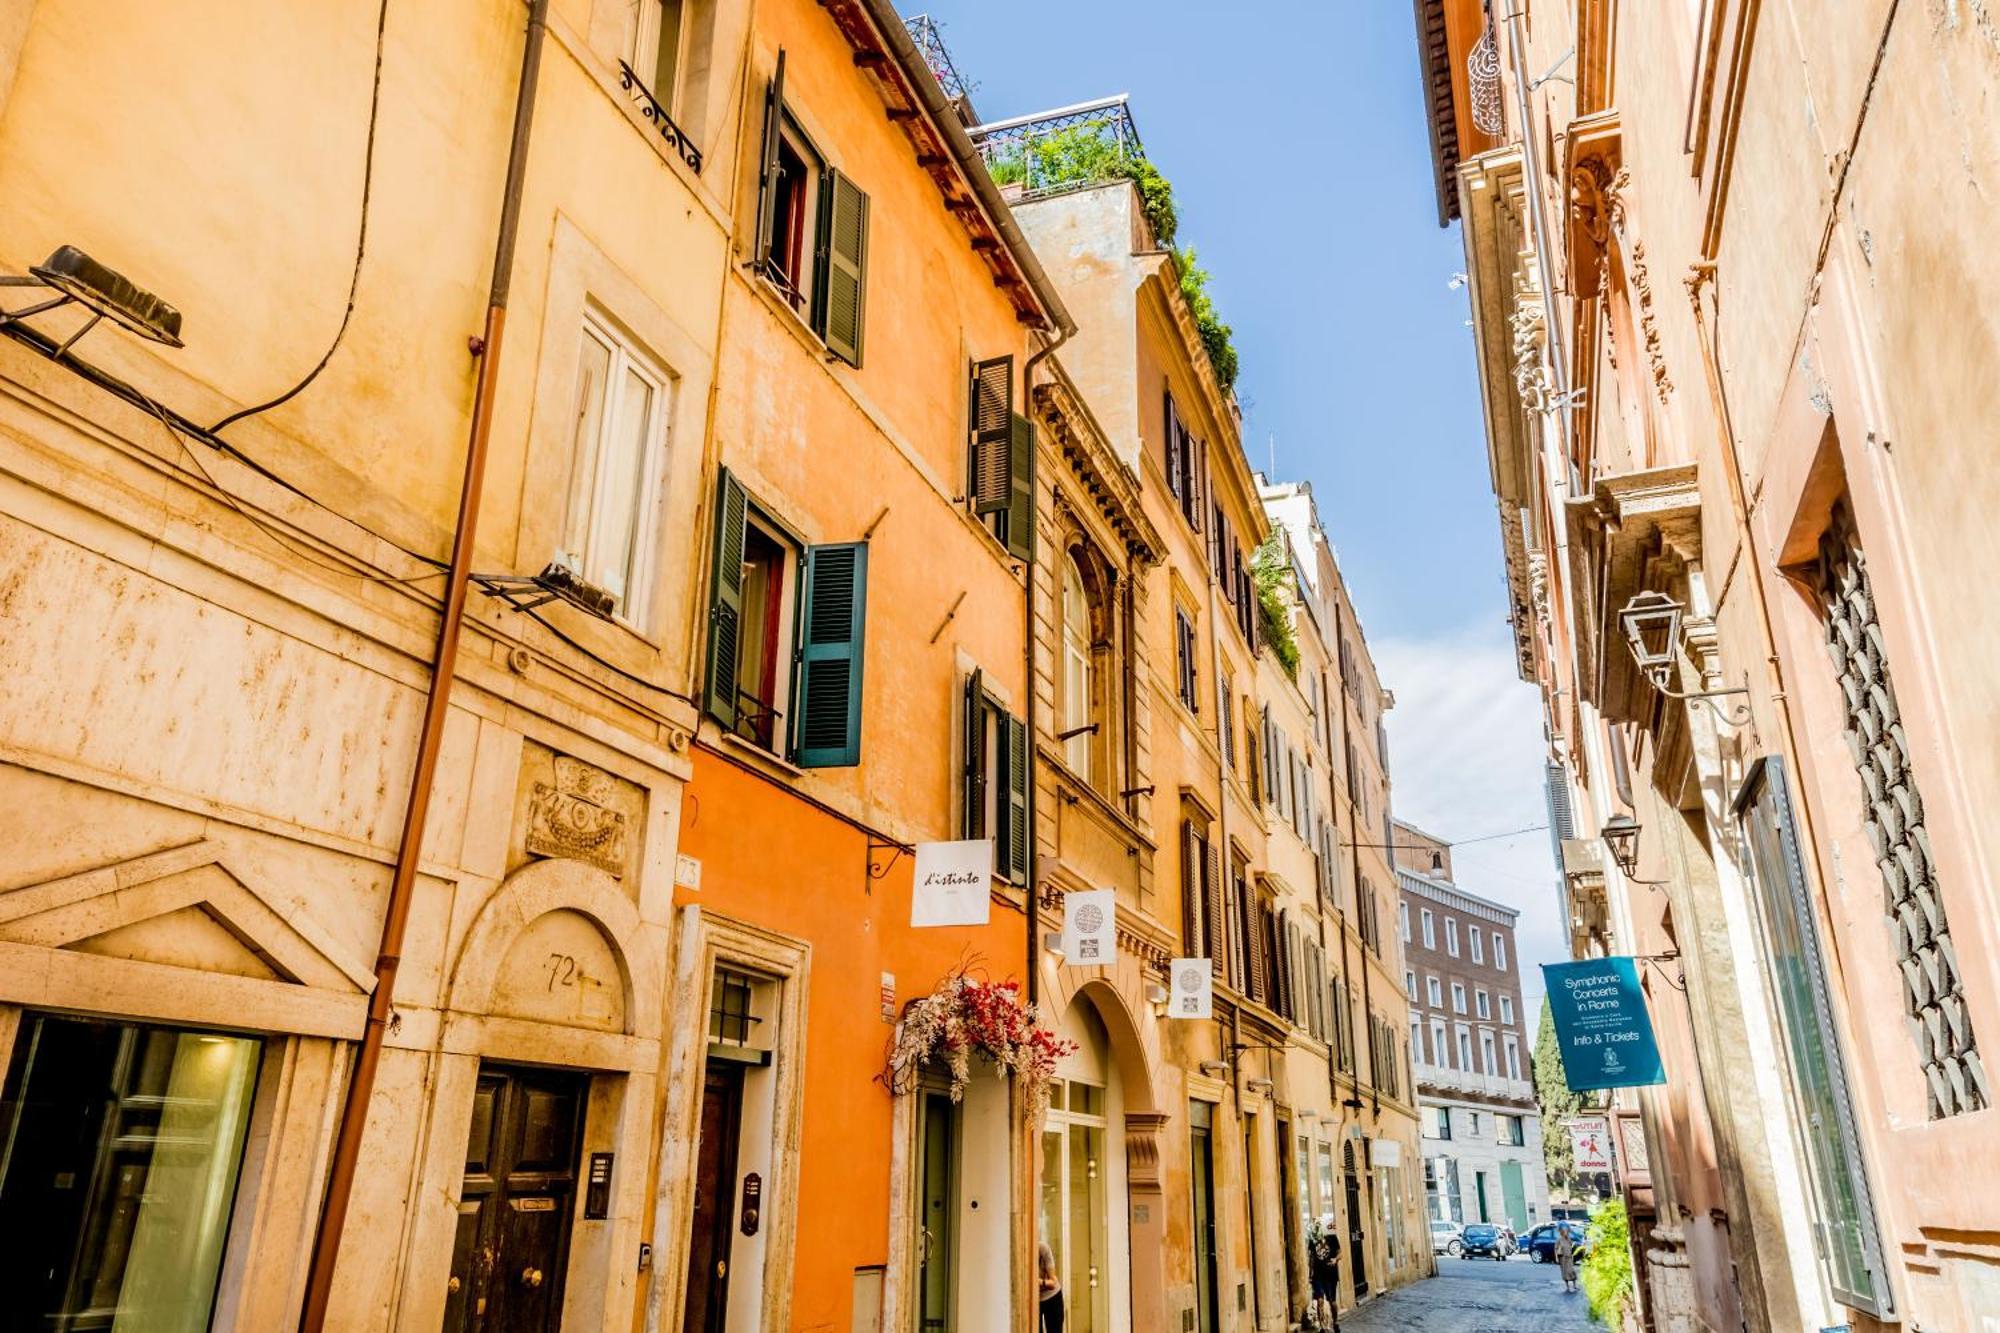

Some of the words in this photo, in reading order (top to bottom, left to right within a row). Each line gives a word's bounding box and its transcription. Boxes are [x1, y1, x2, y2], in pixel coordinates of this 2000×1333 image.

[679, 858, 697, 885] 73
[924, 871, 980, 886] d'istinto
[547, 952, 576, 993] 72
[1565, 974, 1621, 989] Symphonic
[1572, 987, 1619, 1000] Concerts
[1588, 1000, 1620, 1010] Rome
[1574, 1035, 1592, 1046] Info
[1594, 1033, 1602, 1044] &
[1604, 1031, 1640, 1042] Tickets
[1580, 1159, 1607, 1168] donna
